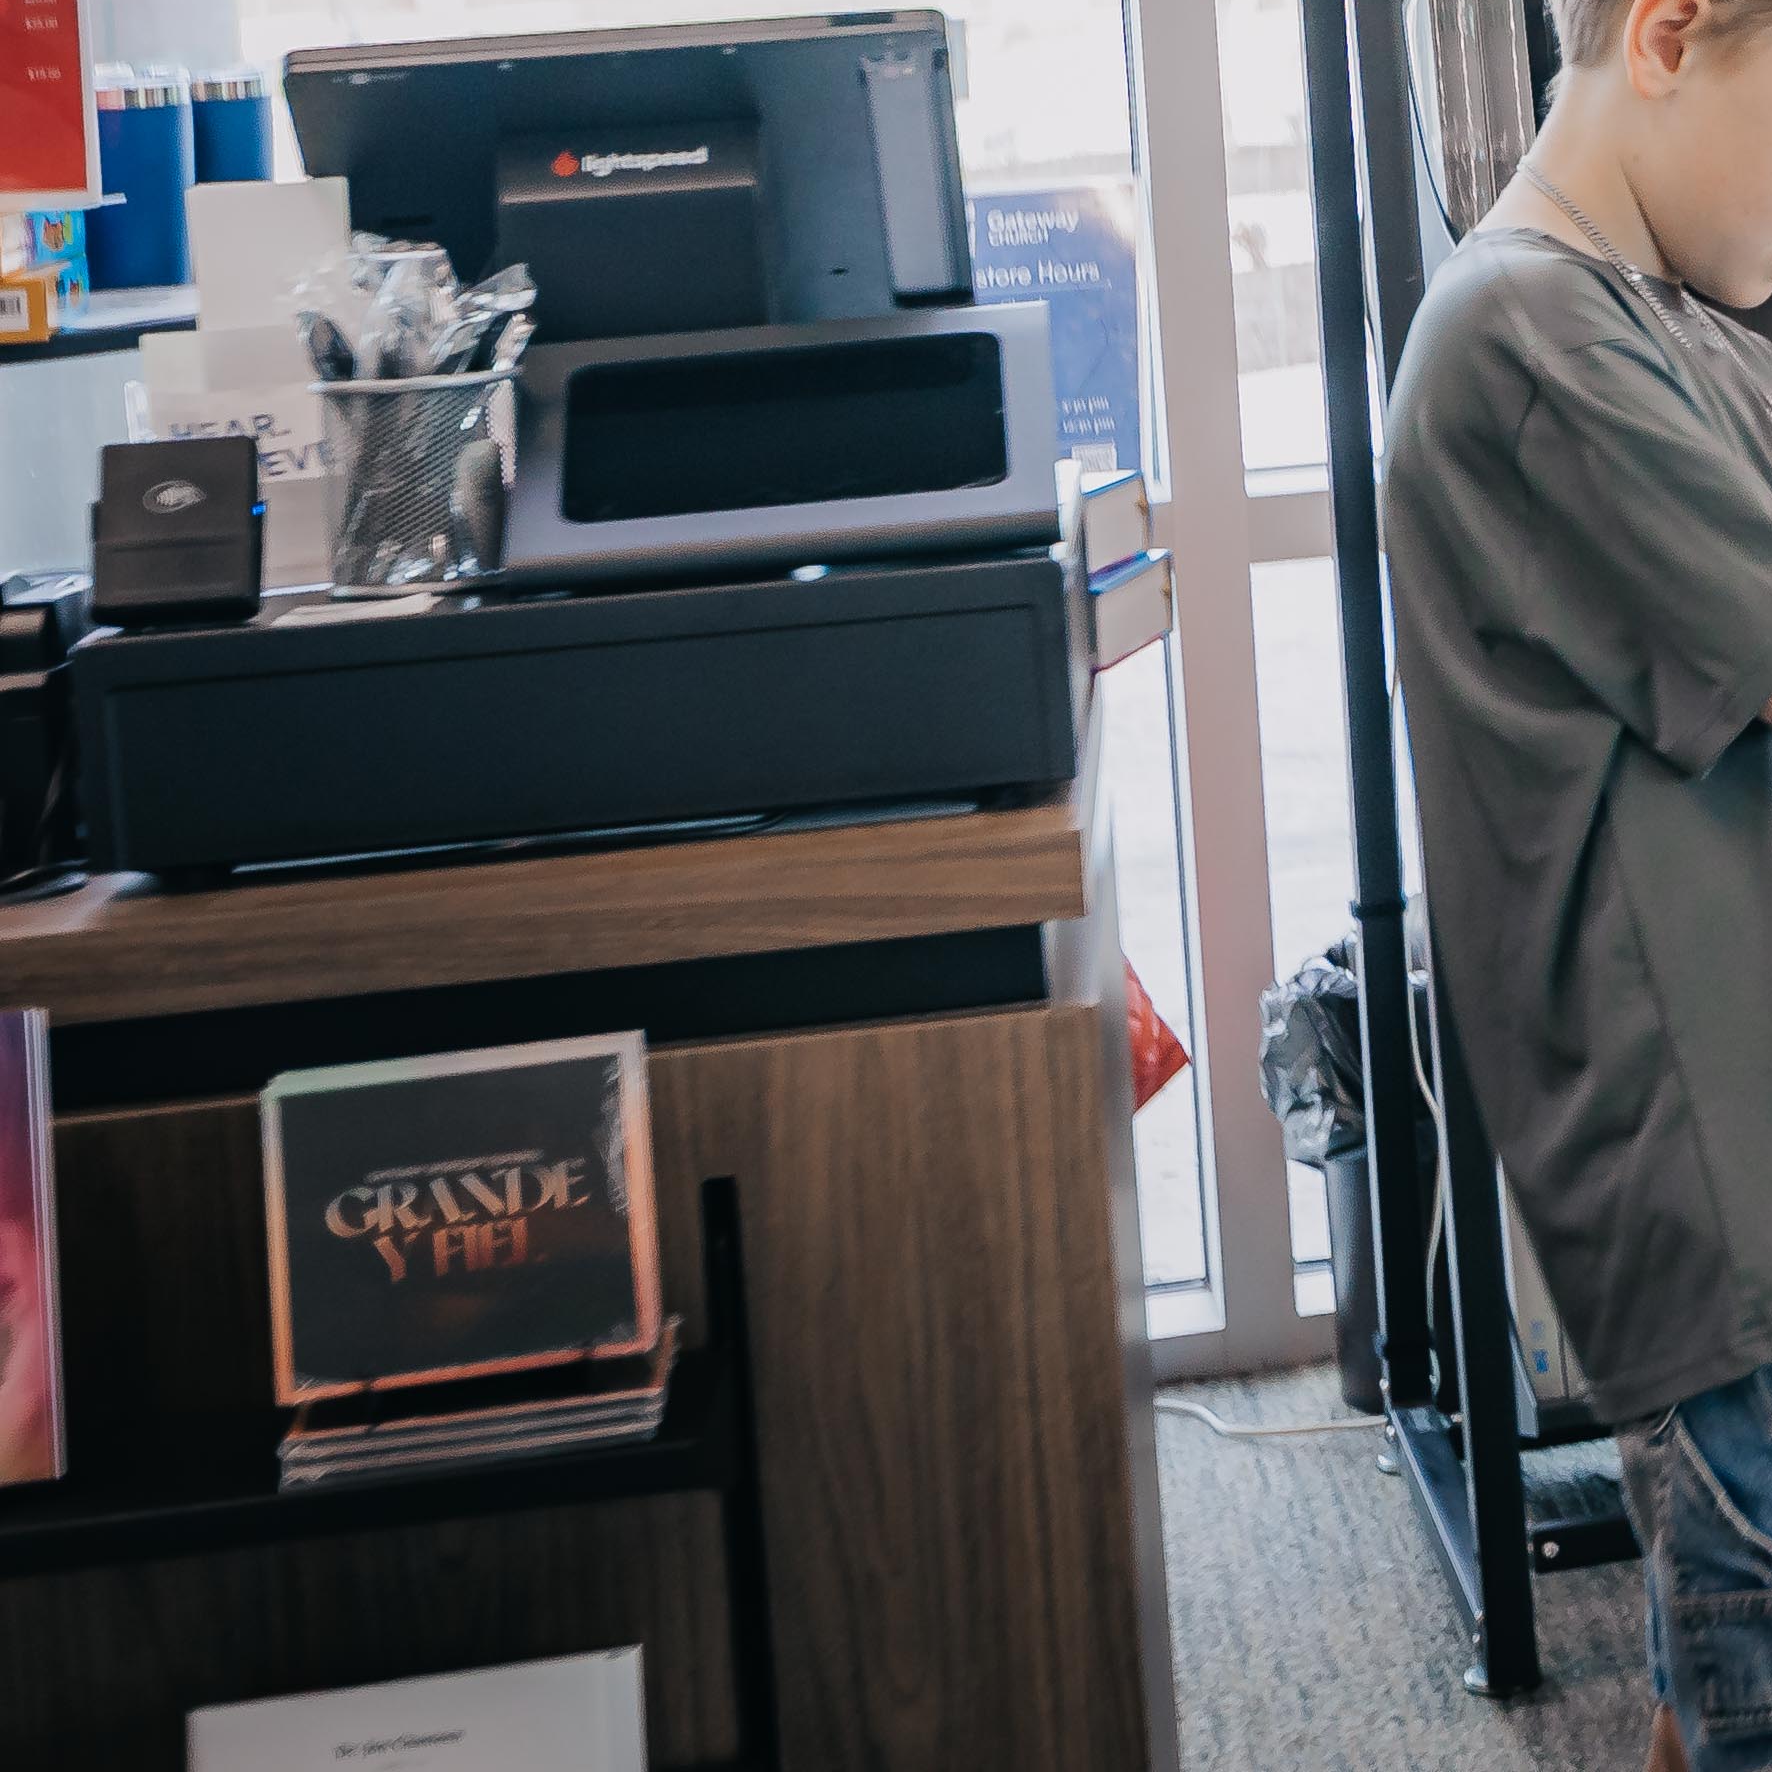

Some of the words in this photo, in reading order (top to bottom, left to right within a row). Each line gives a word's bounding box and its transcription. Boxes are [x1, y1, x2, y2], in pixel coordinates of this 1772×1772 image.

[987, 208, 1080, 233] Gateway
[1037, 259, 1101, 285] Hours
[325, 1157, 594, 1241] GRANDE
